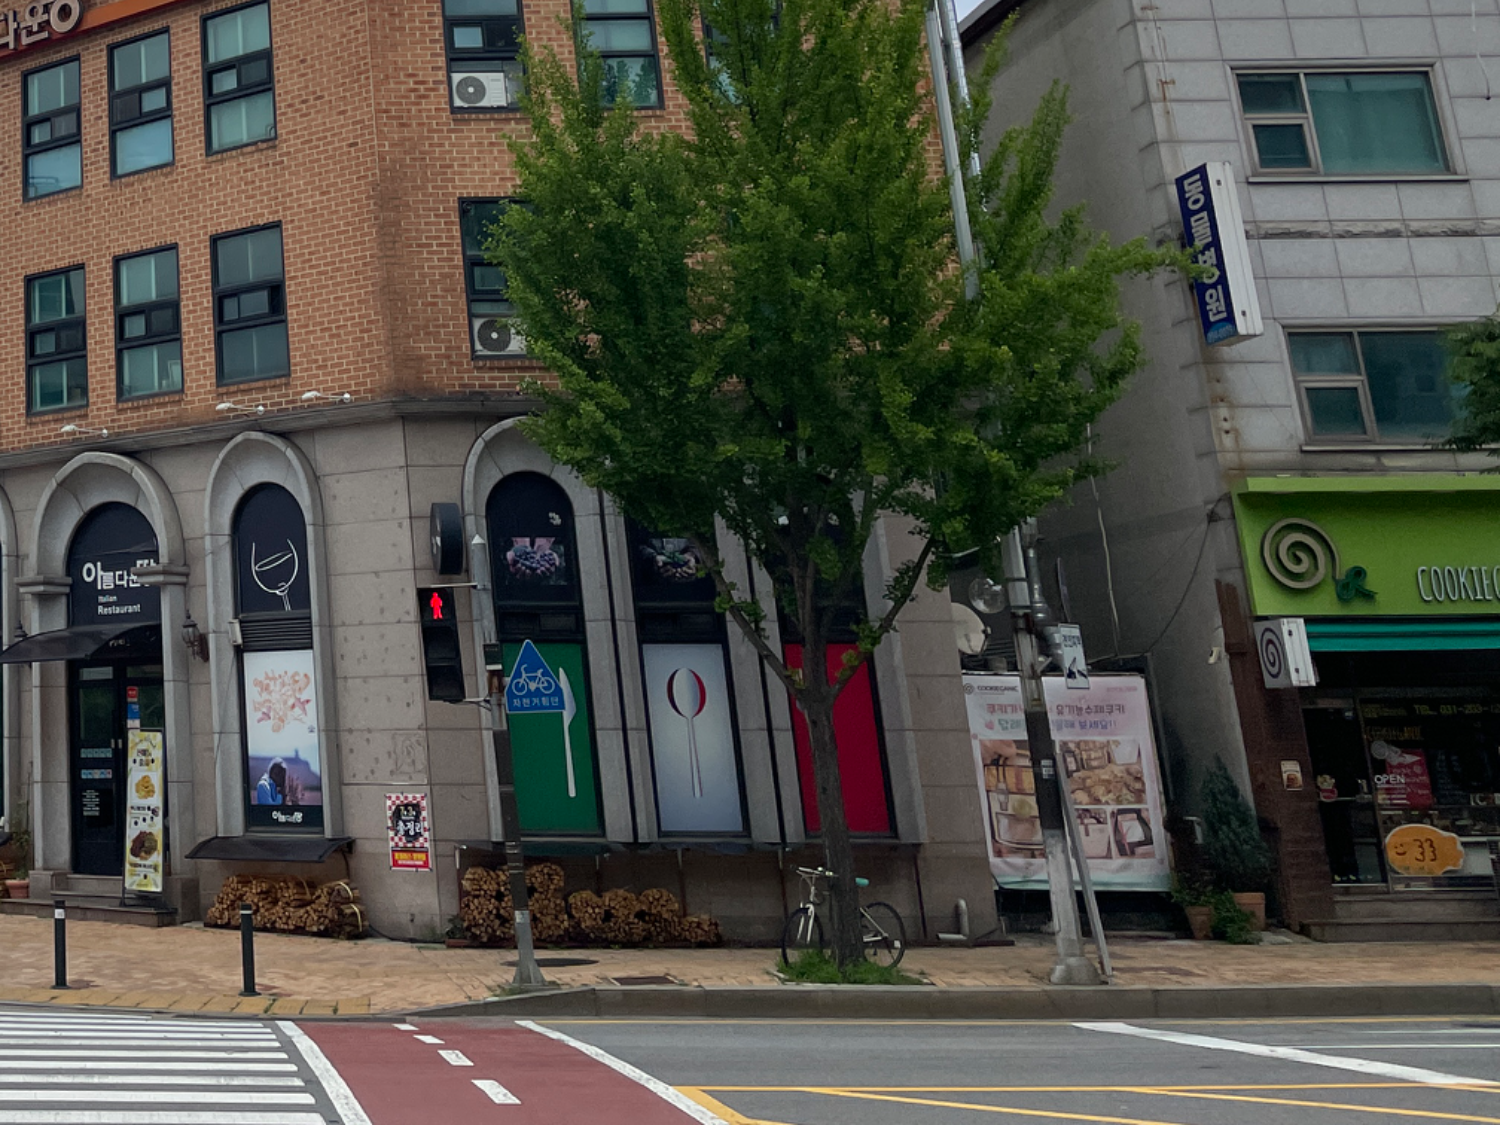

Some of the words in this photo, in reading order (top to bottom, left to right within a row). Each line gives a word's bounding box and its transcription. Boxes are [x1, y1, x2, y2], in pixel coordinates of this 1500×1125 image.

[1183, 174, 1228, 323] 동물병원
[82, 559, 157, 589] 아름다운
[98, 604, 141, 615] Restaurant
[512, 696, 559, 708] 자전거횡단
[1374, 775, 1406, 784] OPEN
